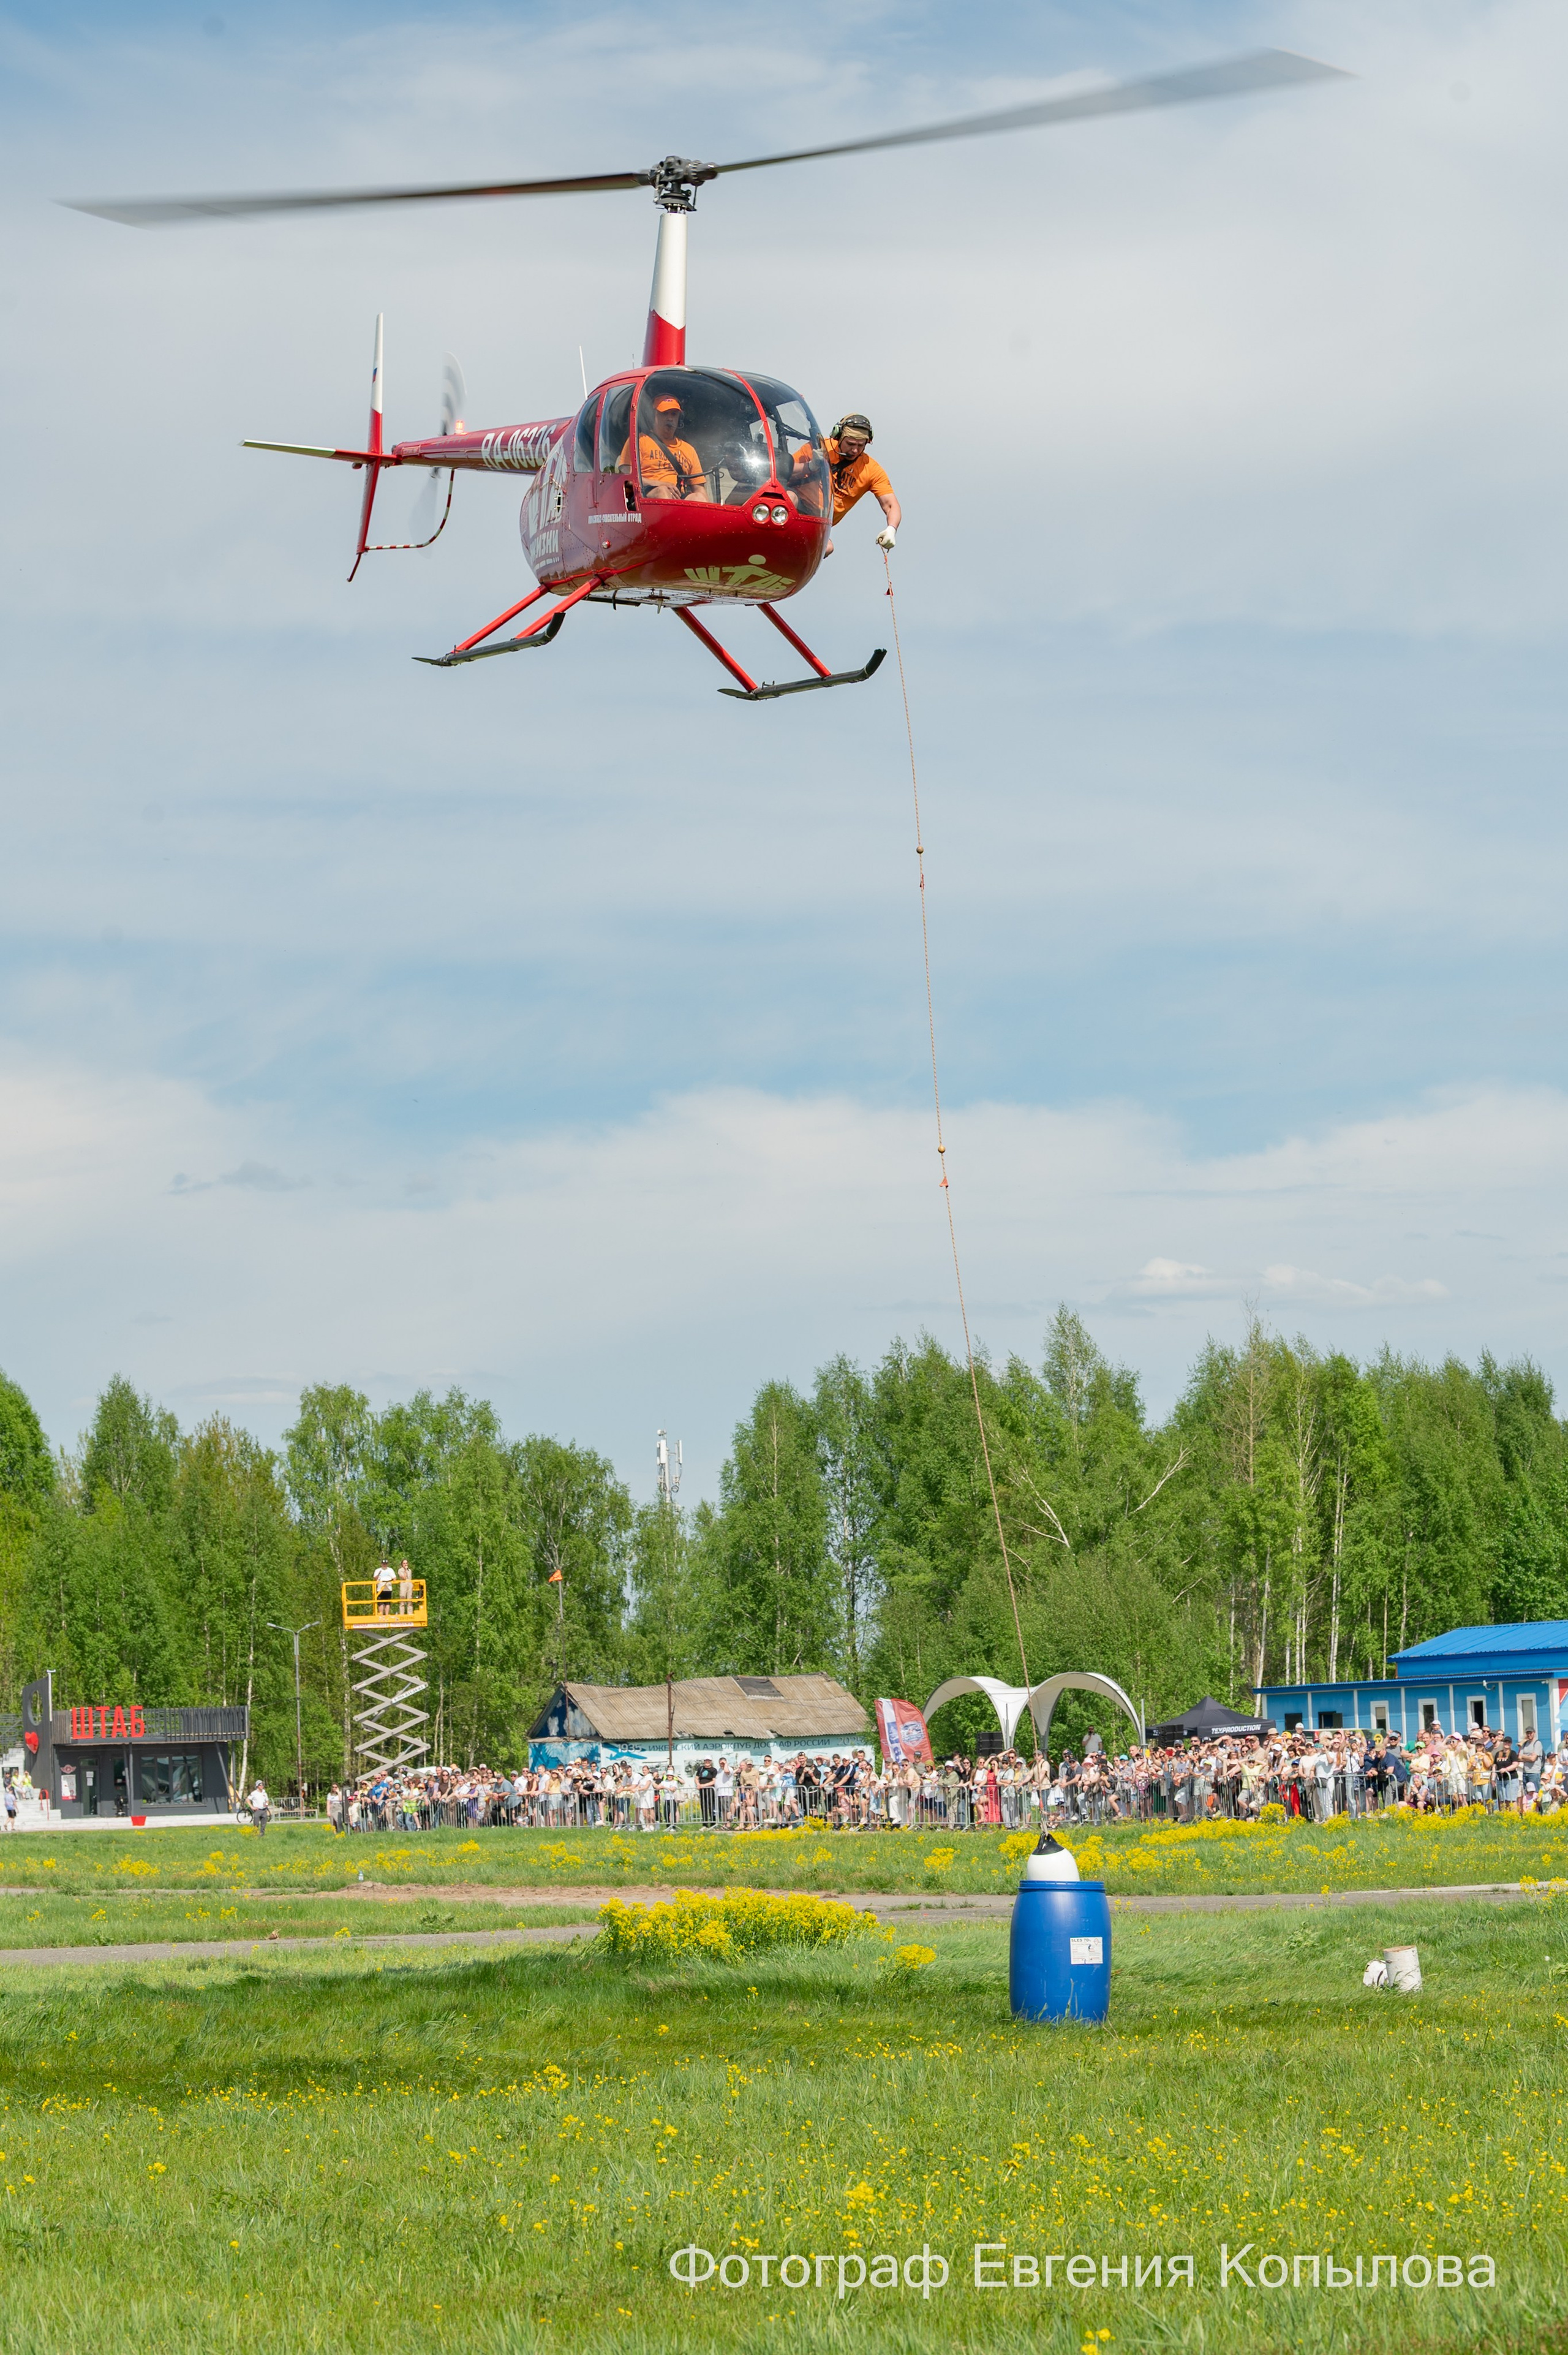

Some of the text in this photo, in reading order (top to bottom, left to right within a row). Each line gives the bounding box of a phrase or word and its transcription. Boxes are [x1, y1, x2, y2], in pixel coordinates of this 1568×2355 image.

[481, 424, 557, 470] RA-06326
[627, 513, 642, 523] ОТРЯД
[530, 529, 559, 563] ЖИЗНИ
[72, 1705, 145, 1739] ШТАБ
[618, 1743, 643, 1753] 1935
[648, 1742, 700, 1752] ИЖЕВСКИЙ
[753, 1741, 791, 1749] ДОСААФ
